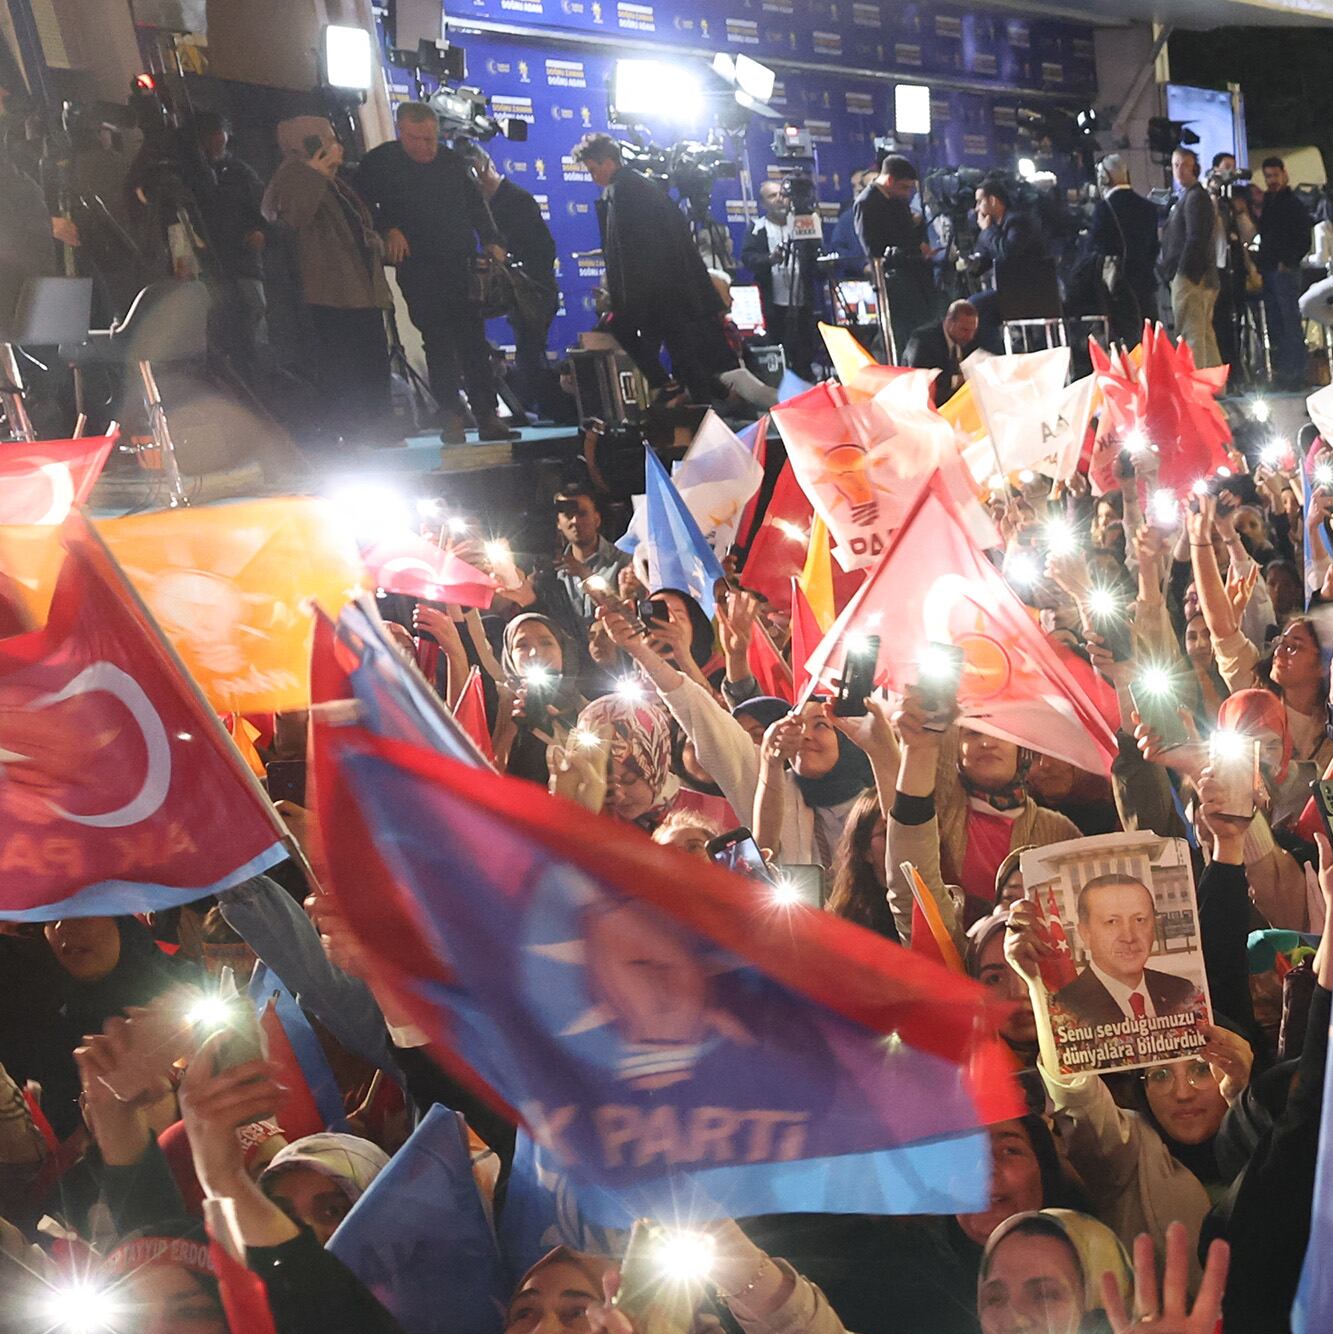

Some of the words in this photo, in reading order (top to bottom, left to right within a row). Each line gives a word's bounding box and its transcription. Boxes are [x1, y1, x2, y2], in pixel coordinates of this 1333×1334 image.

[1057, 1023, 1094, 1044] Senu
[1096, 1010, 1196, 1039] sevduğumuzu
[1062, 1042, 1135, 1067] dünyalara
[1137, 1031, 1207, 1056] bildurdük
[594, 1103, 811, 1167] PARTİ
